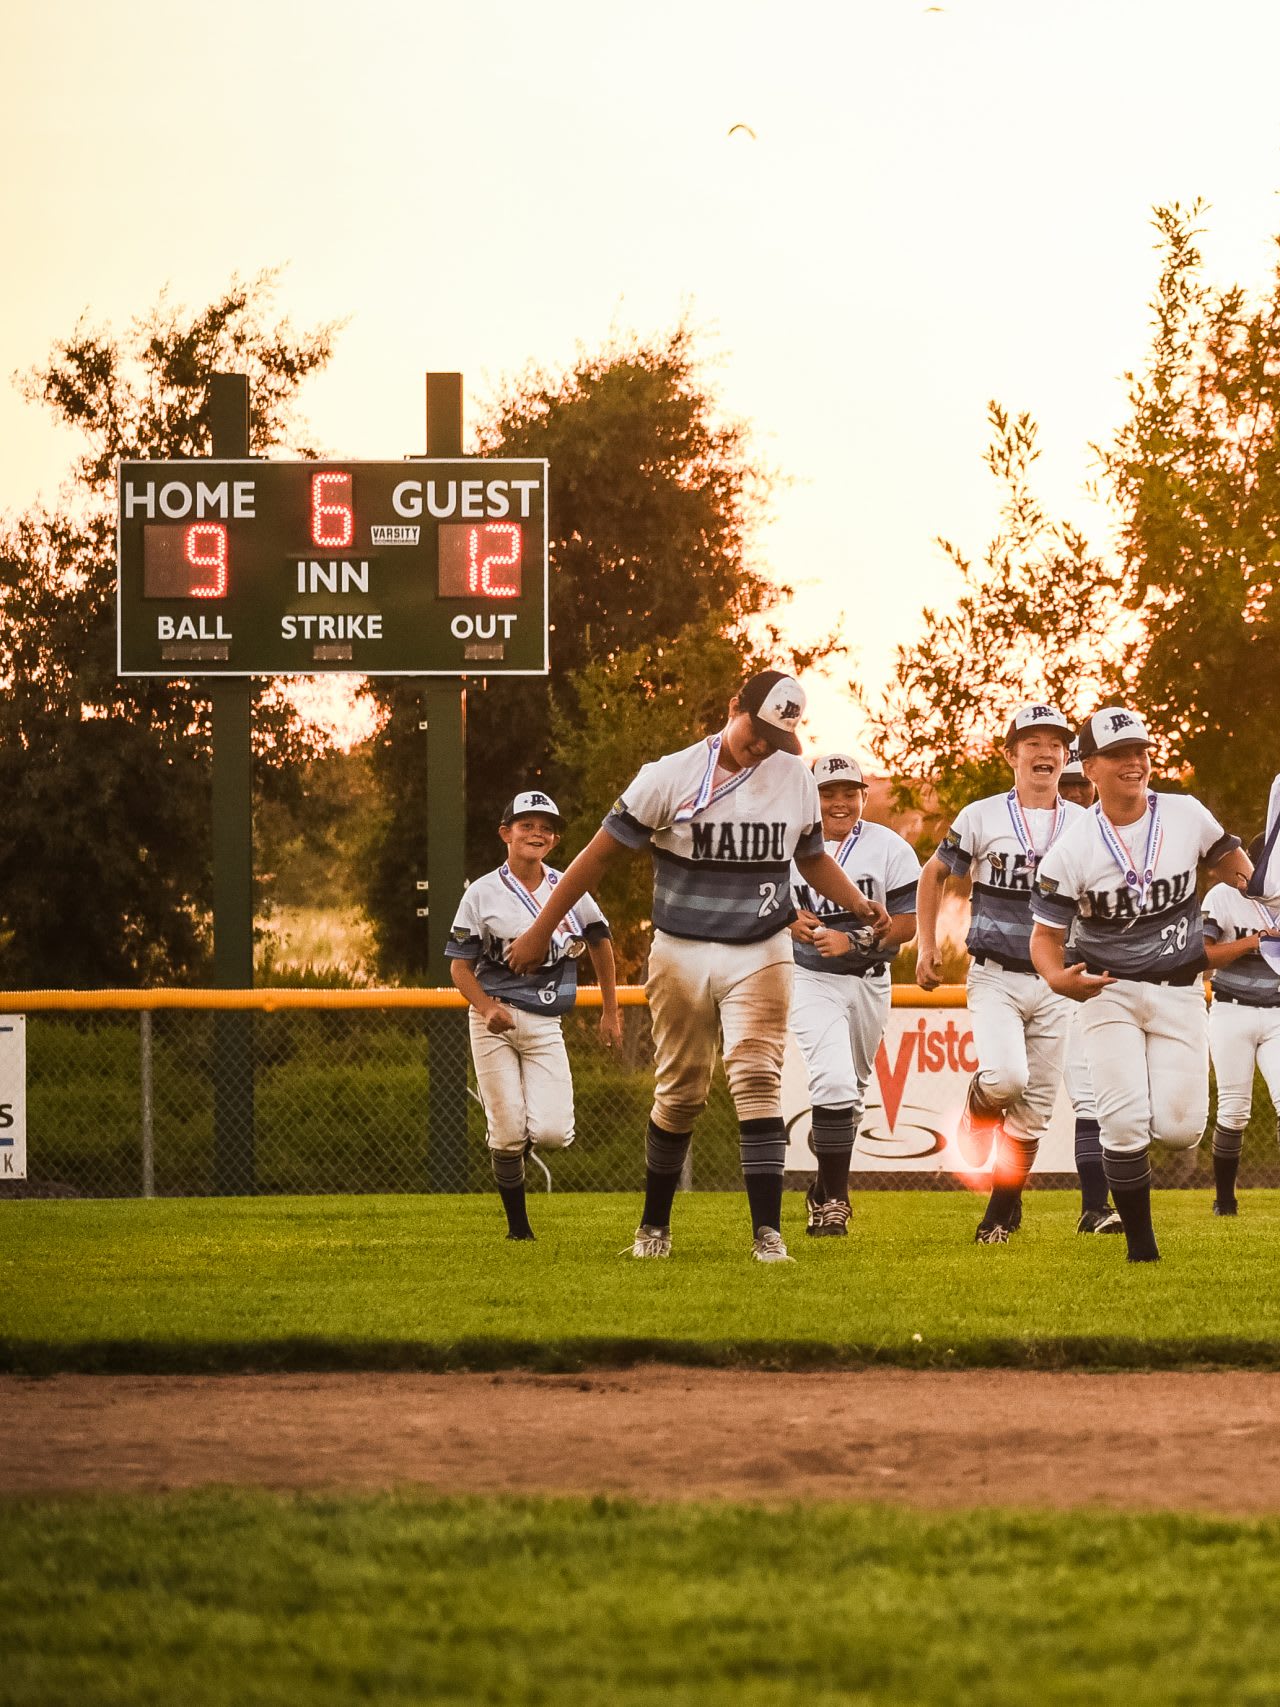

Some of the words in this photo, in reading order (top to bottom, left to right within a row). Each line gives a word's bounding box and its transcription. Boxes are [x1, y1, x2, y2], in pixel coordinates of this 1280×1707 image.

[125, 481, 256, 519] HOME
[311, 472, 354, 548] 6
[392, 480, 540, 518] GUEST
[372, 527, 418, 539] VARSITY
[185, 523, 228, 598] 9
[297, 561, 369, 593] INN
[468, 523, 522, 598] 12
[157, 616, 232, 640] BALL
[281, 615, 383, 640] STRIKE
[450, 614, 518, 640] OUT
[690, 821, 788, 861] MAIDU
[1085, 870, 1191, 919] MADU
[1160, 916, 1189, 957] 28
[537, 980, 558, 1005] 6
